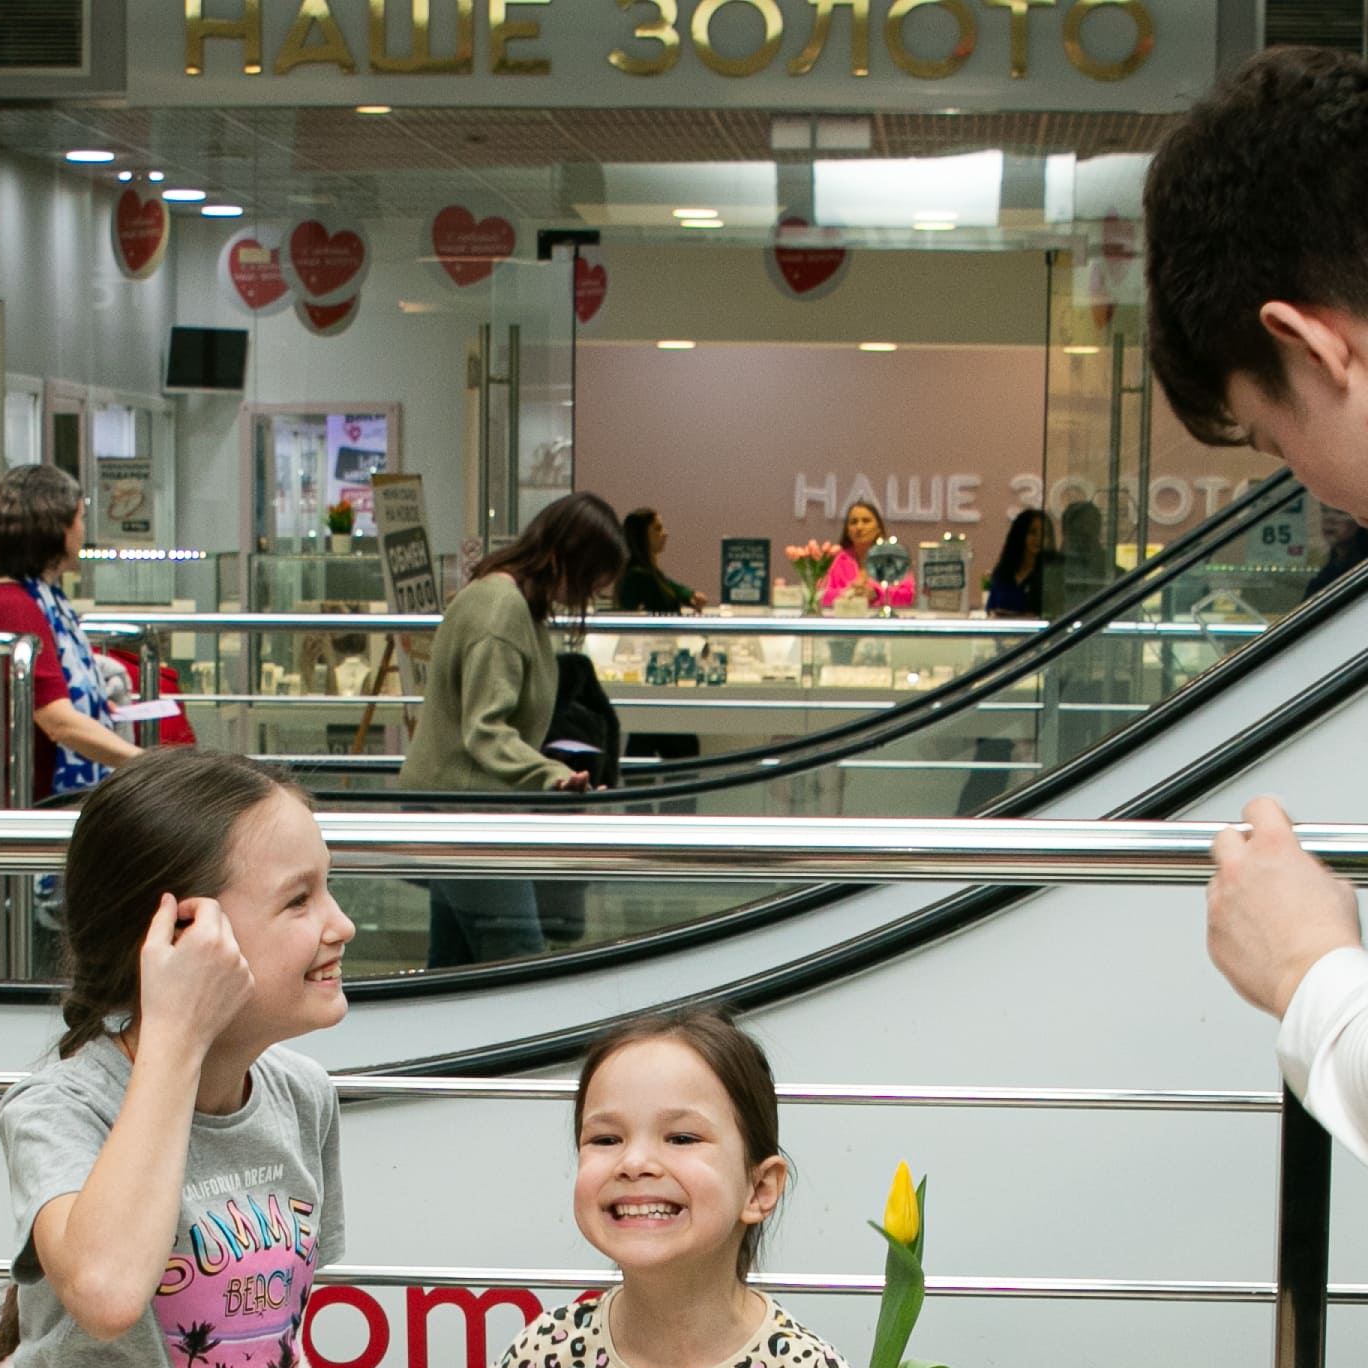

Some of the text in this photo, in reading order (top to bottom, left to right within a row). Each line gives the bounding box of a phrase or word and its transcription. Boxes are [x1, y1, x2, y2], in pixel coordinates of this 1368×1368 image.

[185, 0, 1157, 81] НАШЕ ЗОЛОТО
[793, 472, 983, 524] НАШЕ
[1261, 524, 1293, 546] 85
[244, 1164, 284, 1189] DREAM
